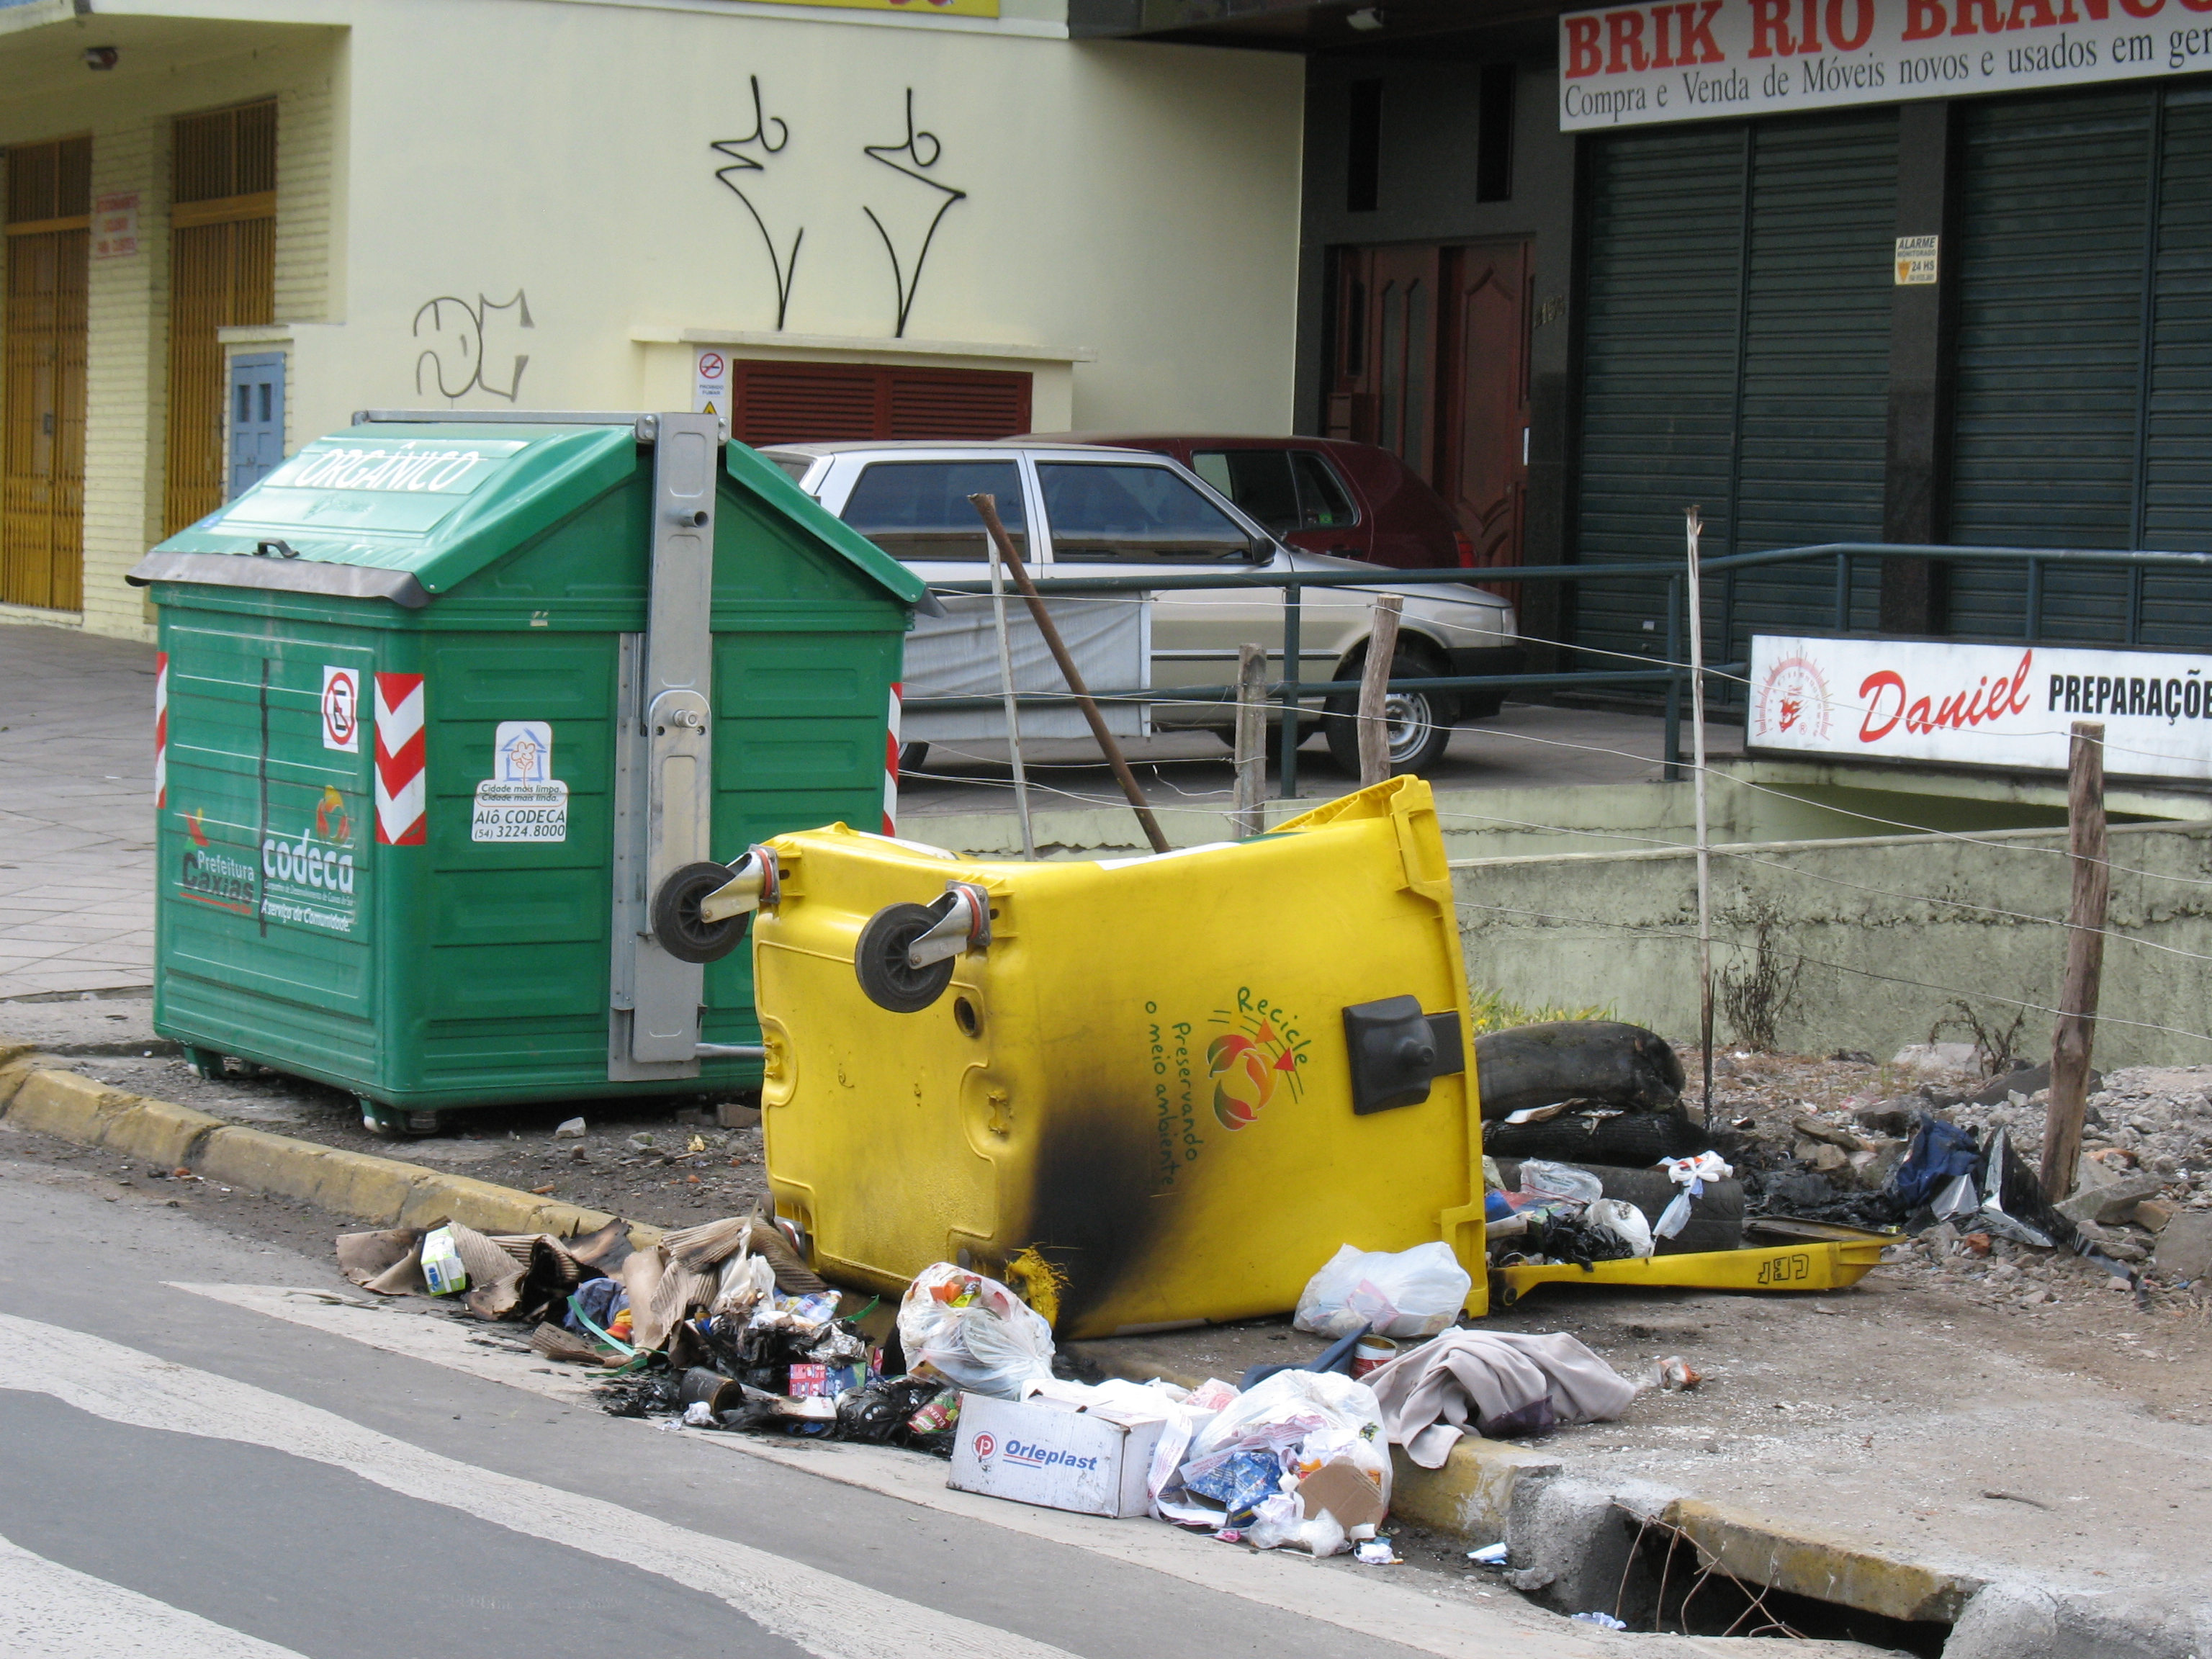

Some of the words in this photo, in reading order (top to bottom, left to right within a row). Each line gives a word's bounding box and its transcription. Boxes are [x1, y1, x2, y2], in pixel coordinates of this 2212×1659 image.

[1565, 0, 1725, 78] BRIK
[1748, 0, 1874, 58] RIO
[1565, 84, 1647, 122] Compra
[1657, 86, 1668, 107] e
[1683, 68, 1750, 104] Venda
[1763, 63, 1789, 97] de
[1802, 52, 1885, 94] Móveis
[1899, 53, 1969, 84] novos
[1981, 50, 1994, 76] e
[2008, 32, 2097, 73] usados
[2112, 33, 2154, 63] em
[1897, 237, 1936, 250] ALARME
[1912, 261, 1921, 271] 24
[1923, 260, 1935, 271] HS
[295, 441, 479, 491] ORGÂNICO
[1858, 649, 2033, 742] Daniel
[481, 783, 511, 793] Cidade
[536, 784, 562, 795] limpa.
[475, 809, 500, 824] Alô
[505, 809, 565, 824] CODECA
[475, 829, 493, 840] (54)
[496, 824, 565, 837] 3224.8000
[182, 852, 254, 904] Caxias
[197, 850, 255, 881] Prefeitura
[263, 829, 354, 893] codeca
[1145, 1001, 1156, 1014] o
[1237, 986, 1311, 1066] Recicle
[1149, 1024, 1171, 1074] meio
[1172, 1022, 1203, 1161] Preservando
[1156, 1084, 1181, 1185] ambiente
[1005, 1439, 1097, 1471] Orleplast
